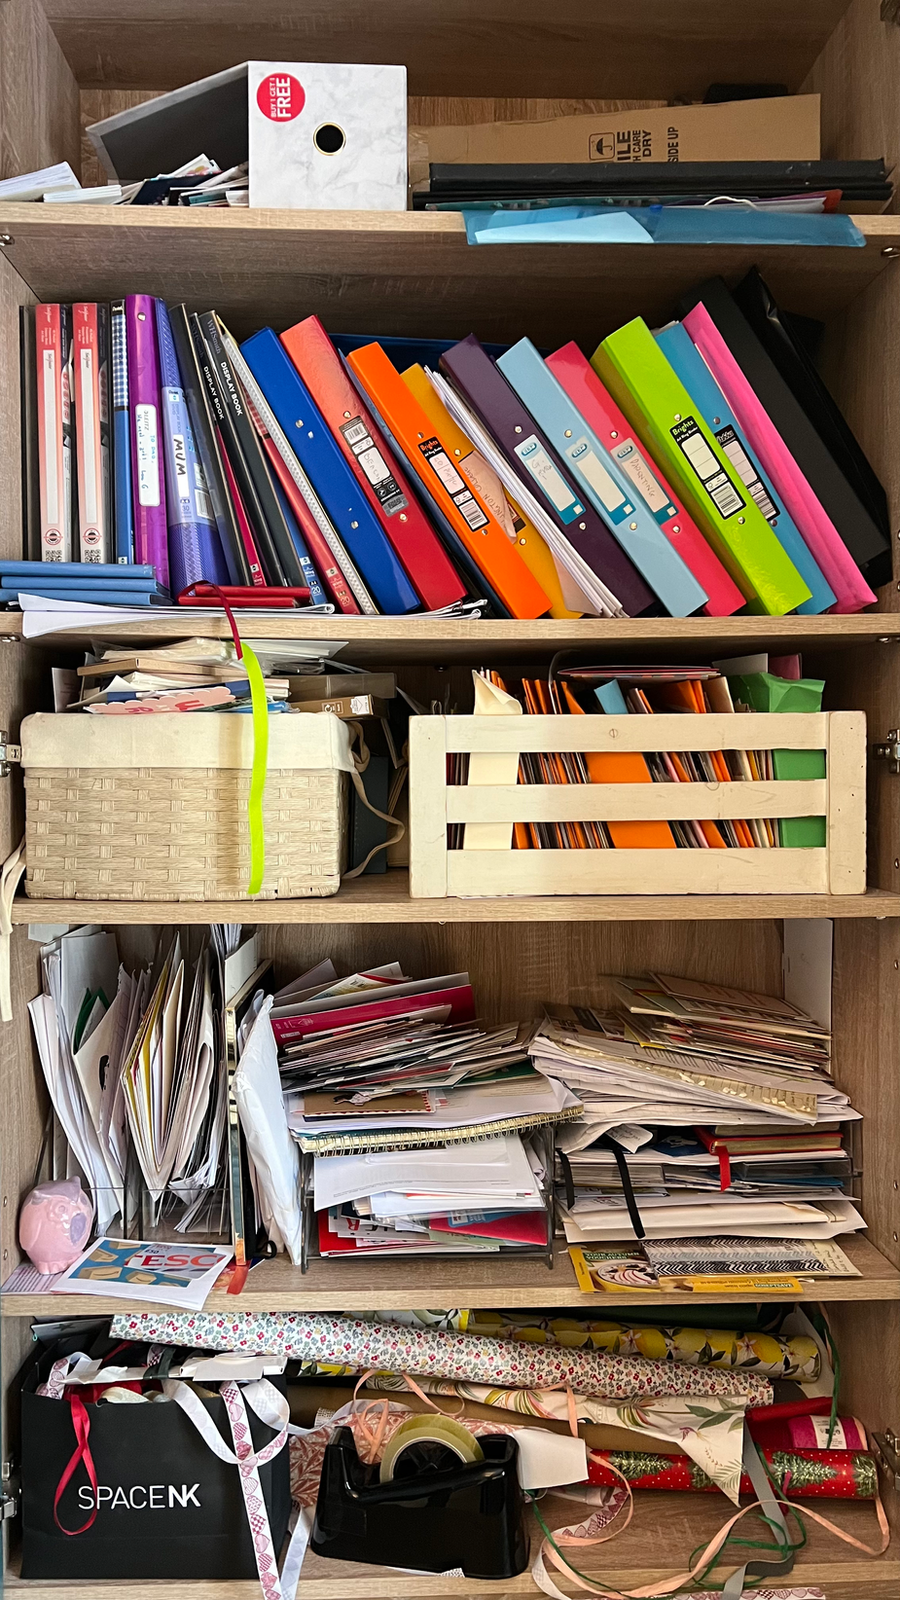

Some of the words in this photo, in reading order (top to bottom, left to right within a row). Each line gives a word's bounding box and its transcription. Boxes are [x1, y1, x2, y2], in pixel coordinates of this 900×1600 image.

[276, 77, 292, 118] FREE
[632, 130, 641, 153] CARE
[642, 130, 652, 157] DRY
[667, 126, 679, 140] UP
[207, 319, 222, 355] WHSmith
[204, 366, 217, 396] DISPLAY
[214, 397, 225, 420] BOOK
[220, 361, 236, 392] DISPLAY
[231, 393, 244, 417] BOOK
[672, 419, 694, 436] Brights
[173, 438, 186, 476] MUM
[630, 458, 656, 497] PARENTING
[311, 586, 321, 594] 20
